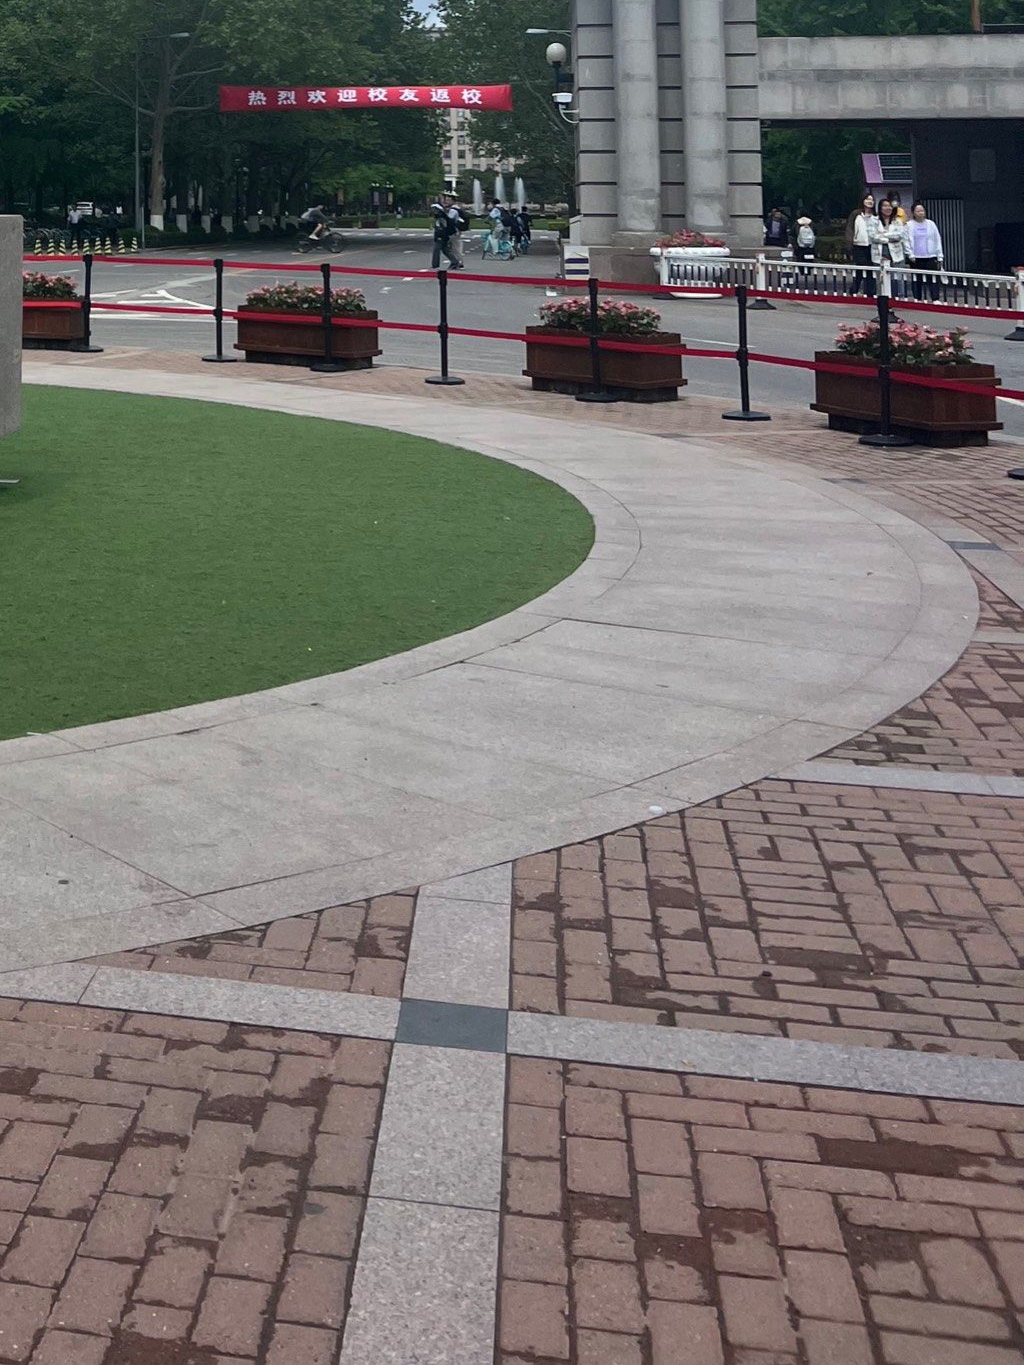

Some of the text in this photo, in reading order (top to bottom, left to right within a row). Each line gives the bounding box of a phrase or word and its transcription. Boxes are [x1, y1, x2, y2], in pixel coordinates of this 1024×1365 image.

[247, 87, 482, 105] 热烈欢迎校友返校
